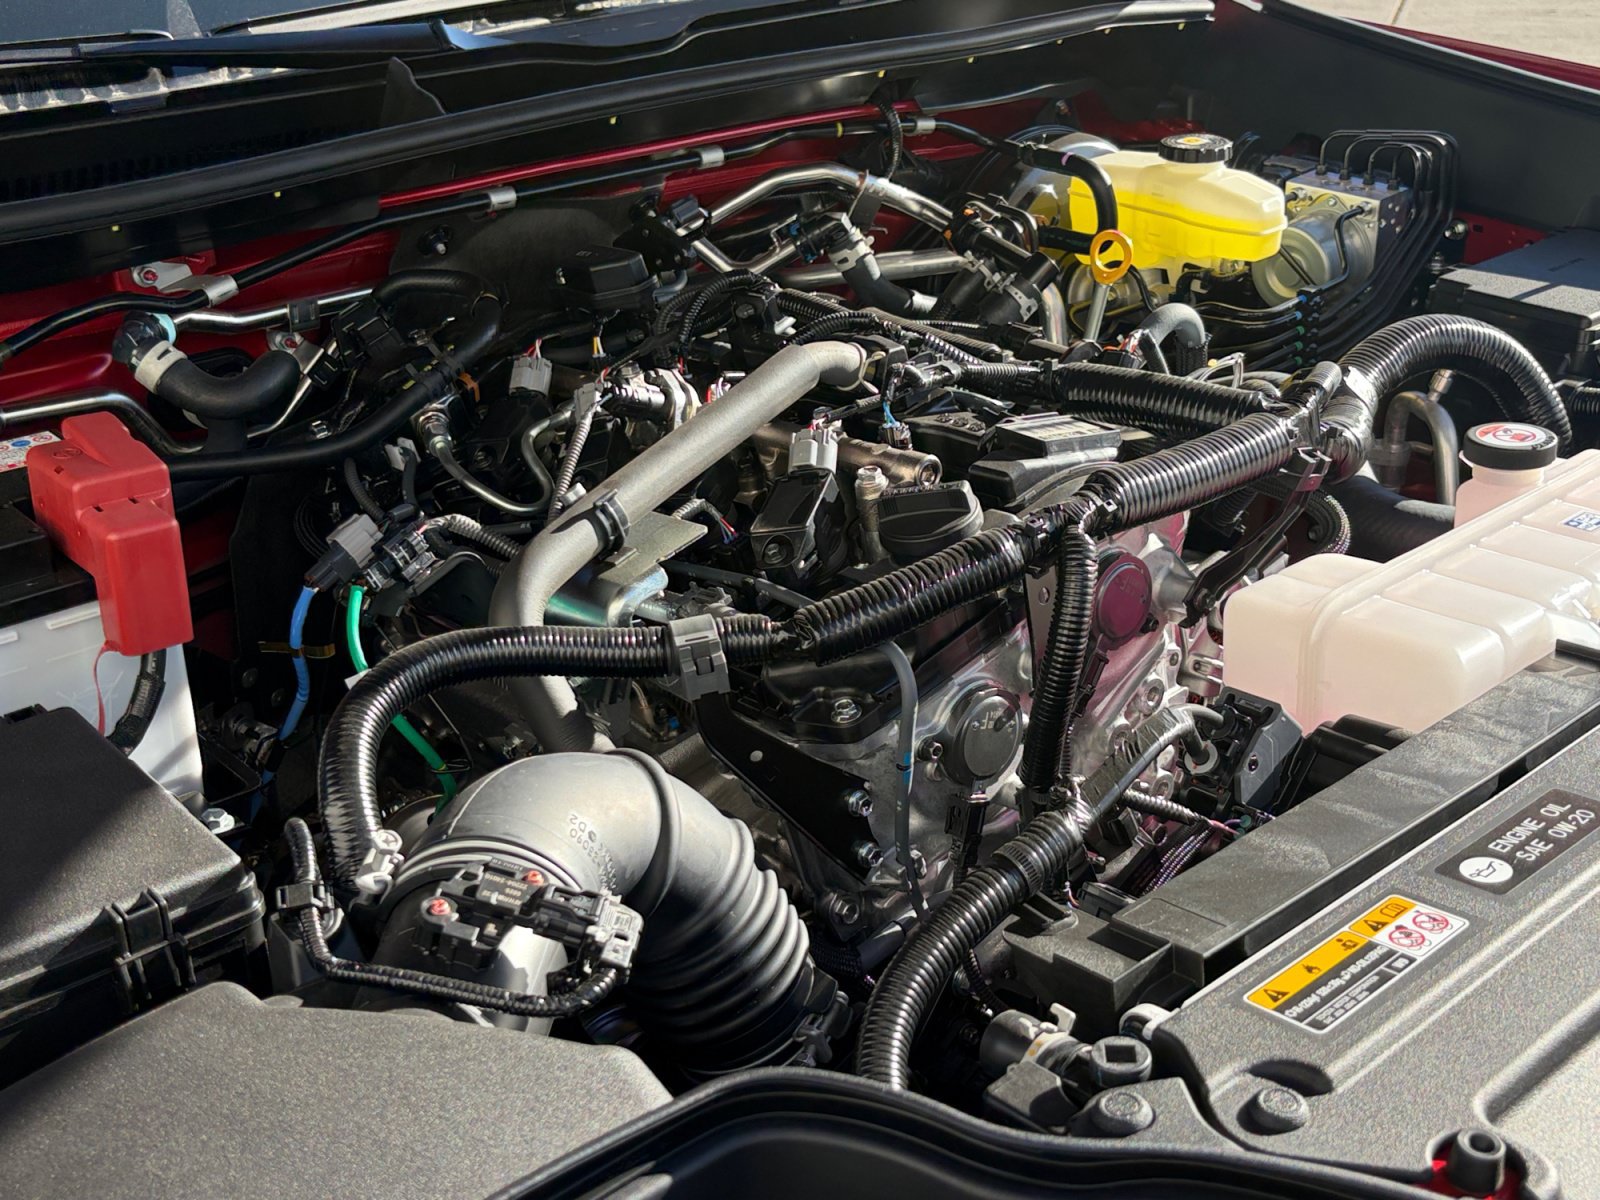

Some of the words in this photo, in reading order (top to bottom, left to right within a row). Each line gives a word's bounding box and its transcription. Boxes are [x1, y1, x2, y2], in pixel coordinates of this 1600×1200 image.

[1488, 817, 1546, 853] ENGINE
[1540, 803, 1571, 817] OIL
[1516, 838, 1554, 861] SAE
